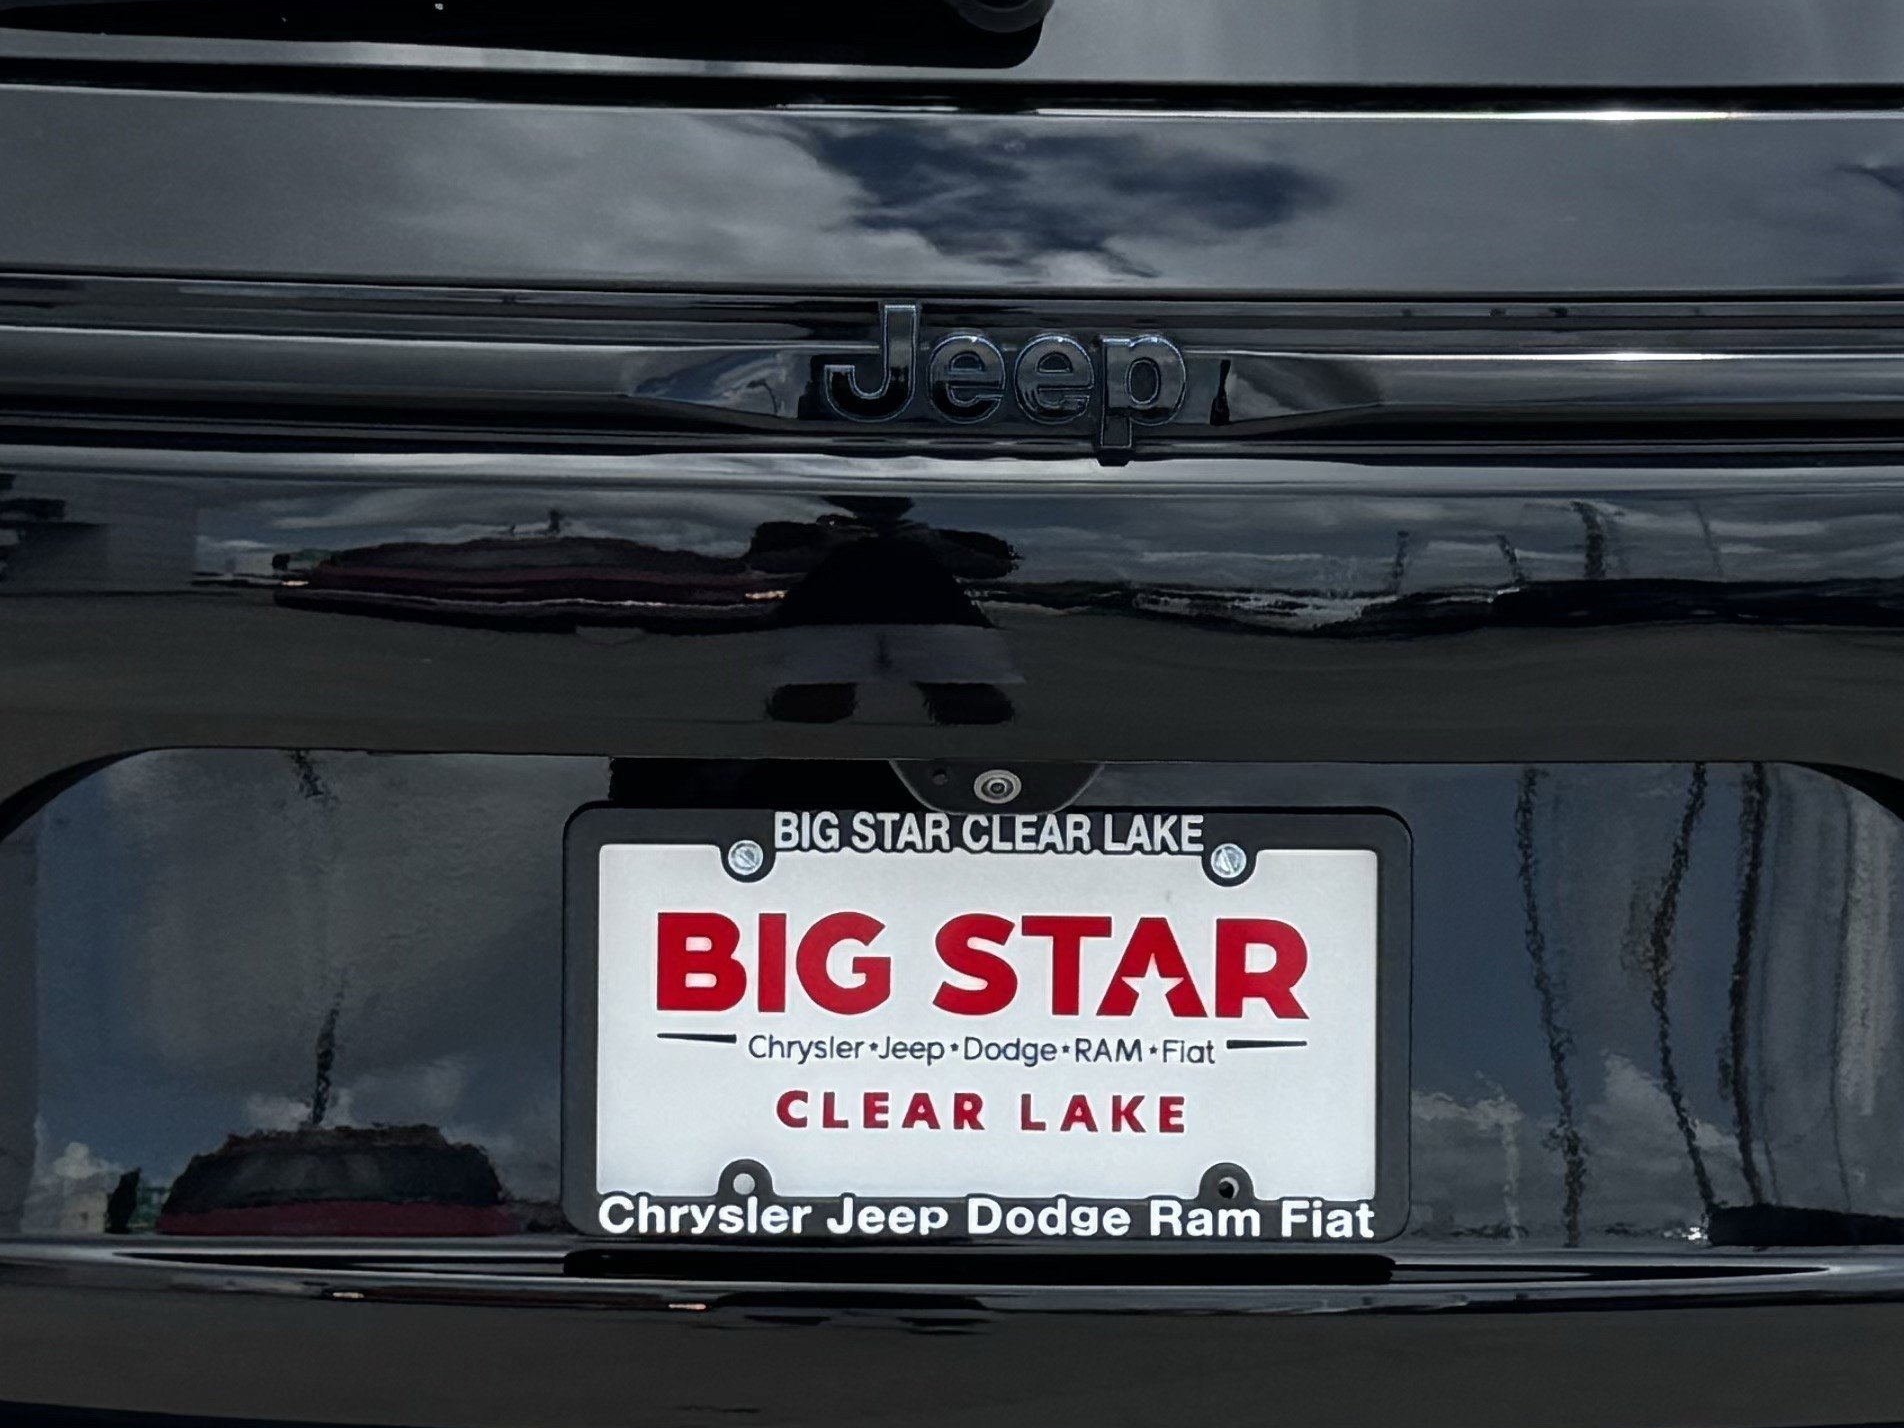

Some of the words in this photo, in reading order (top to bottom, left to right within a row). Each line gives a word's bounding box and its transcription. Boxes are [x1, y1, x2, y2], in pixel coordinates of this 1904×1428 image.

[824, 303, 1187, 448] Jeep
[775, 812, 840, 851] BIG
[851, 812, 951, 852] STAR
[962, 813, 1092, 854] CLEAR
[1103, 814, 1205, 854] LAKE
[656, 912, 892, 1016] BIG
[934, 915, 1309, 1020] STAR
[748, 1034, 864, 1065] Chrysler
[776, 1090, 984, 1130] CLEAR
[1021, 1095, 1187, 1134] LAKE
[598, 1196, 813, 1238] Chrysler
[826, 1197, 949, 1237] Jeep
[966, 1198, 1131, 1238] Dodge
[1149, 1200, 1262, 1238] Ram
[1280, 1201, 1377, 1240] Fiat
